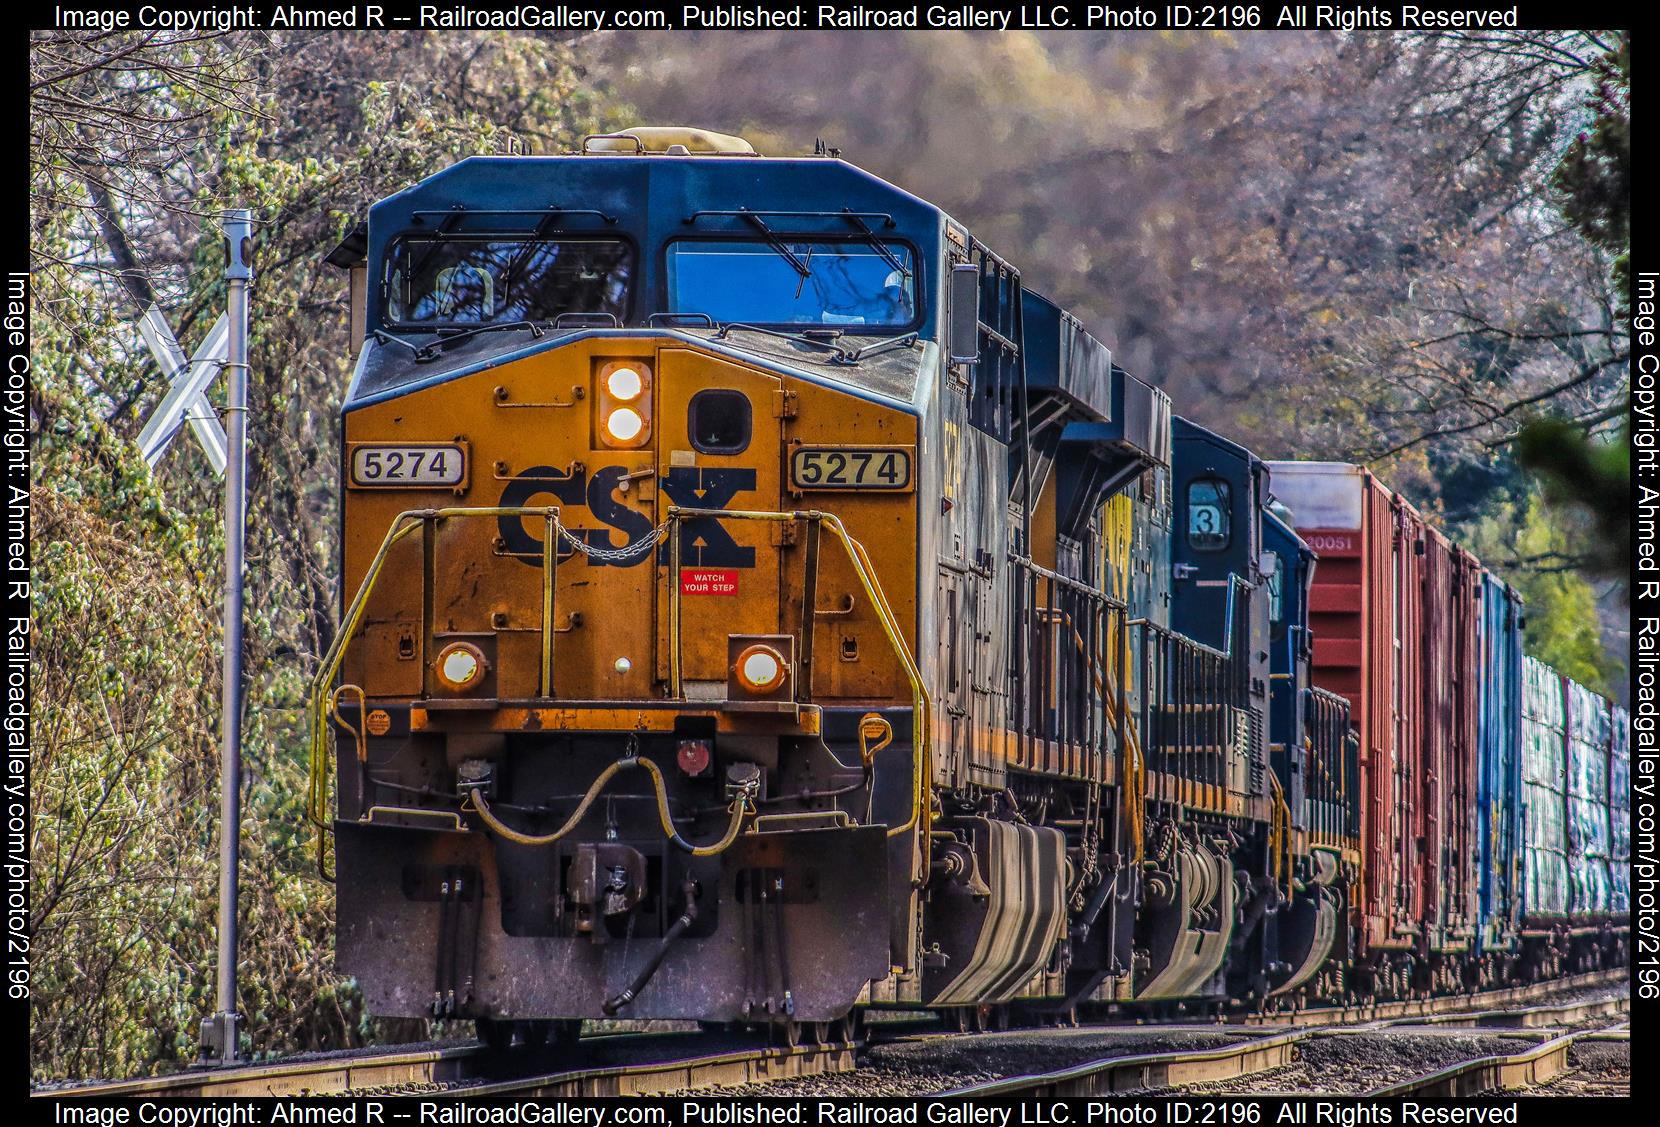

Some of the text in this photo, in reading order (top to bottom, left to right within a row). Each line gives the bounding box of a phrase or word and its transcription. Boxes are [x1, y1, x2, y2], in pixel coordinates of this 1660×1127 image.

[363, 450, 448, 480] 5274
[801, 450, 900, 485] 5274
[499, 465, 756, 568] CSX
[684, 583, 735, 592] YOUR STEP
[694, 574, 725, 582] WATCH
